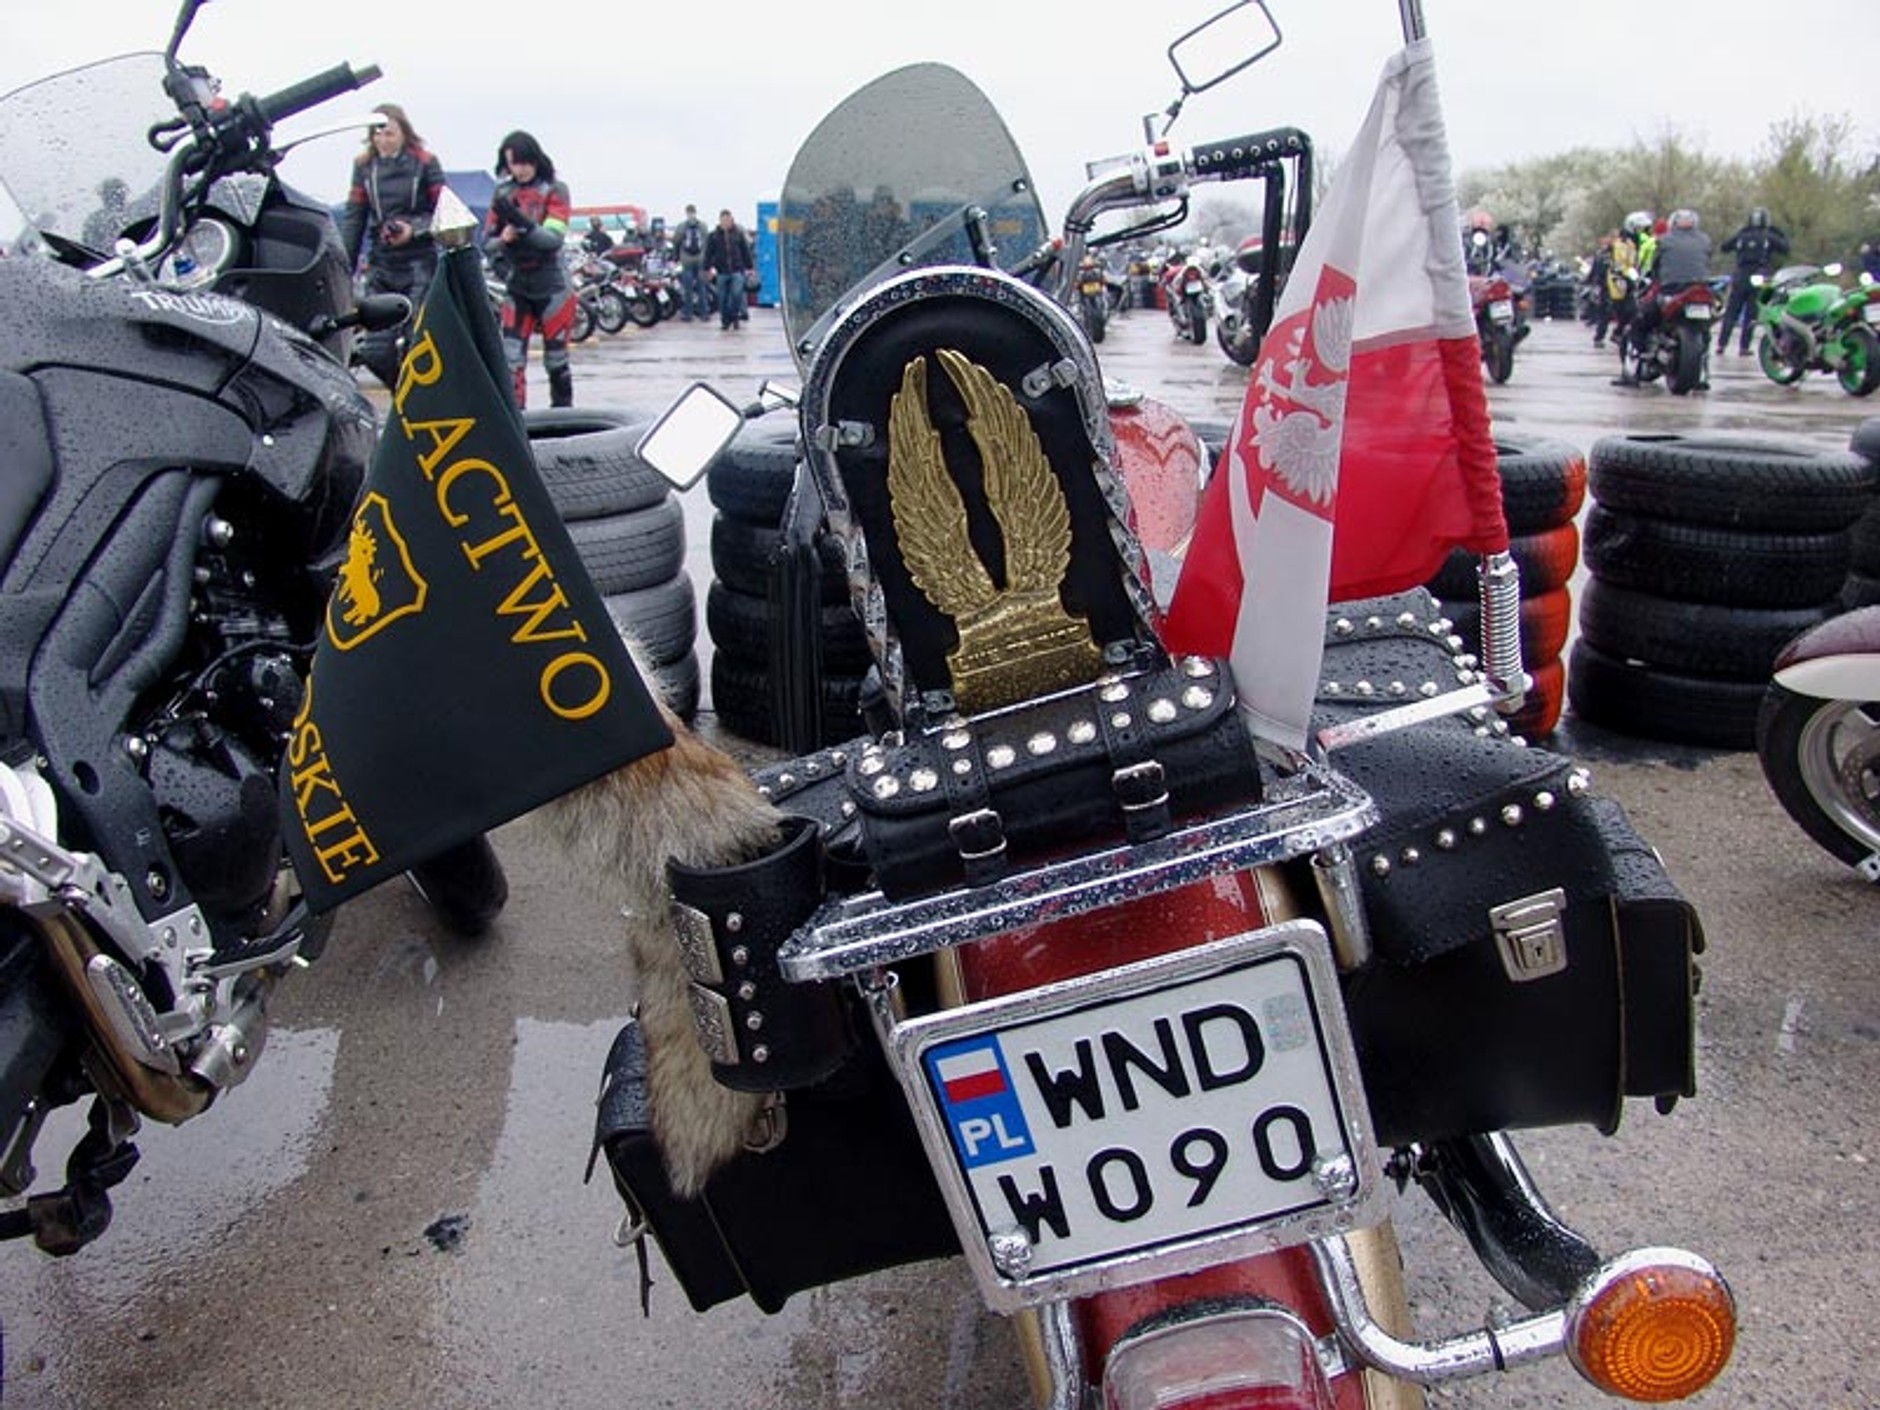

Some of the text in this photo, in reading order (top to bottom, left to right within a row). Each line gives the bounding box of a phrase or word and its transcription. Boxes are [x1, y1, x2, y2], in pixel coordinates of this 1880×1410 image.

[395, 304, 611, 721] RACTWO
[289, 675, 379, 884] SKIE
[959, 1112, 1025, 1158] PL
[1024, 1003, 1265, 1129] WND
[997, 1105, 1317, 1245] W090
